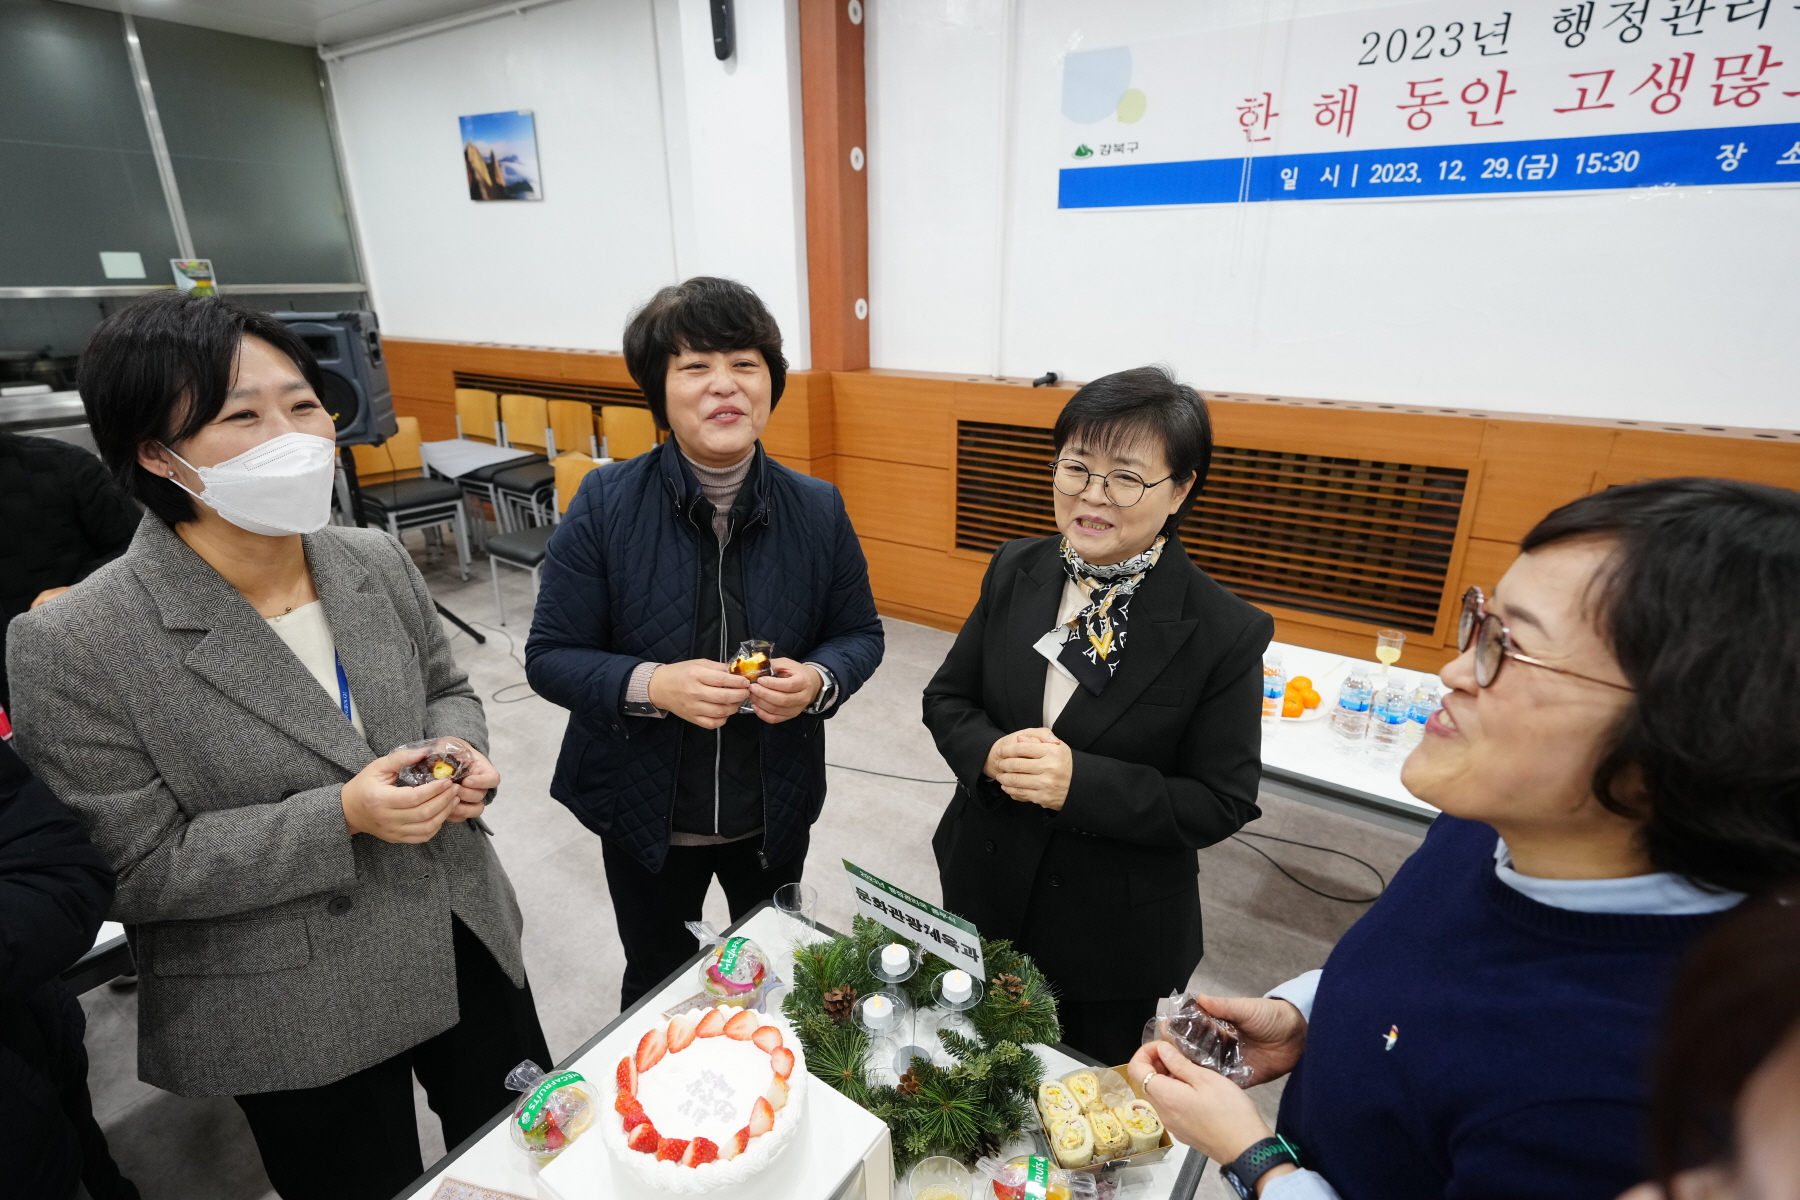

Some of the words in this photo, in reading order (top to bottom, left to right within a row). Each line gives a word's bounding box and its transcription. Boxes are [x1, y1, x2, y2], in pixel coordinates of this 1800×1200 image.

[1357, 12, 1512, 66] 2023년
[1553, 0, 1800, 48] 행정관리
[1236, 92, 1279, 143] 한
[1313, 84, 1359, 137] 해
[1396, 69, 1517, 131] 동안
[1553, 45, 1800, 115] 고생많
[1099, 141, 1139, 156] 강북구
[1369, 163, 1422, 184] 2023.
[1438, 160, 1467, 181] 12.
[1575, 150, 1640, 174] 15:30
[1715, 142, 1748, 172] 장
[855, 886, 980, 963] 문화관광체육과
